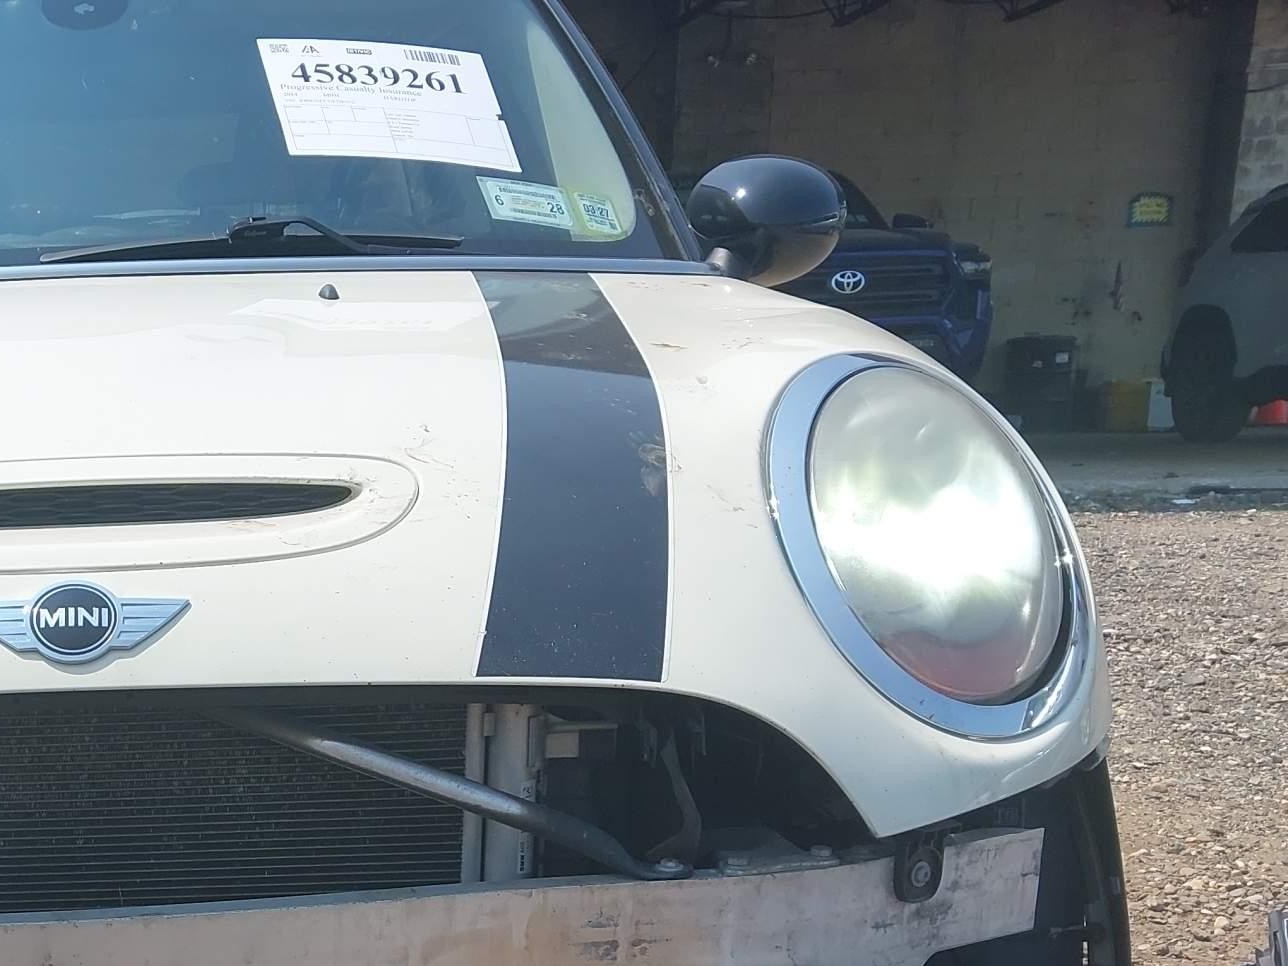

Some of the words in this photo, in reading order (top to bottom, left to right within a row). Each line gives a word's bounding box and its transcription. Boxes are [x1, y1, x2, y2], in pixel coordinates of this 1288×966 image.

[291, 62, 467, 94] 45839261
[280, 83, 334, 92] Progressive
[336, 85, 376, 94] Casualty
[379, 87, 422, 96] Insurance
[494, 194, 504, 206] 6
[546, 202, 565, 215] 28
[39, 606, 109, 628] MINI
